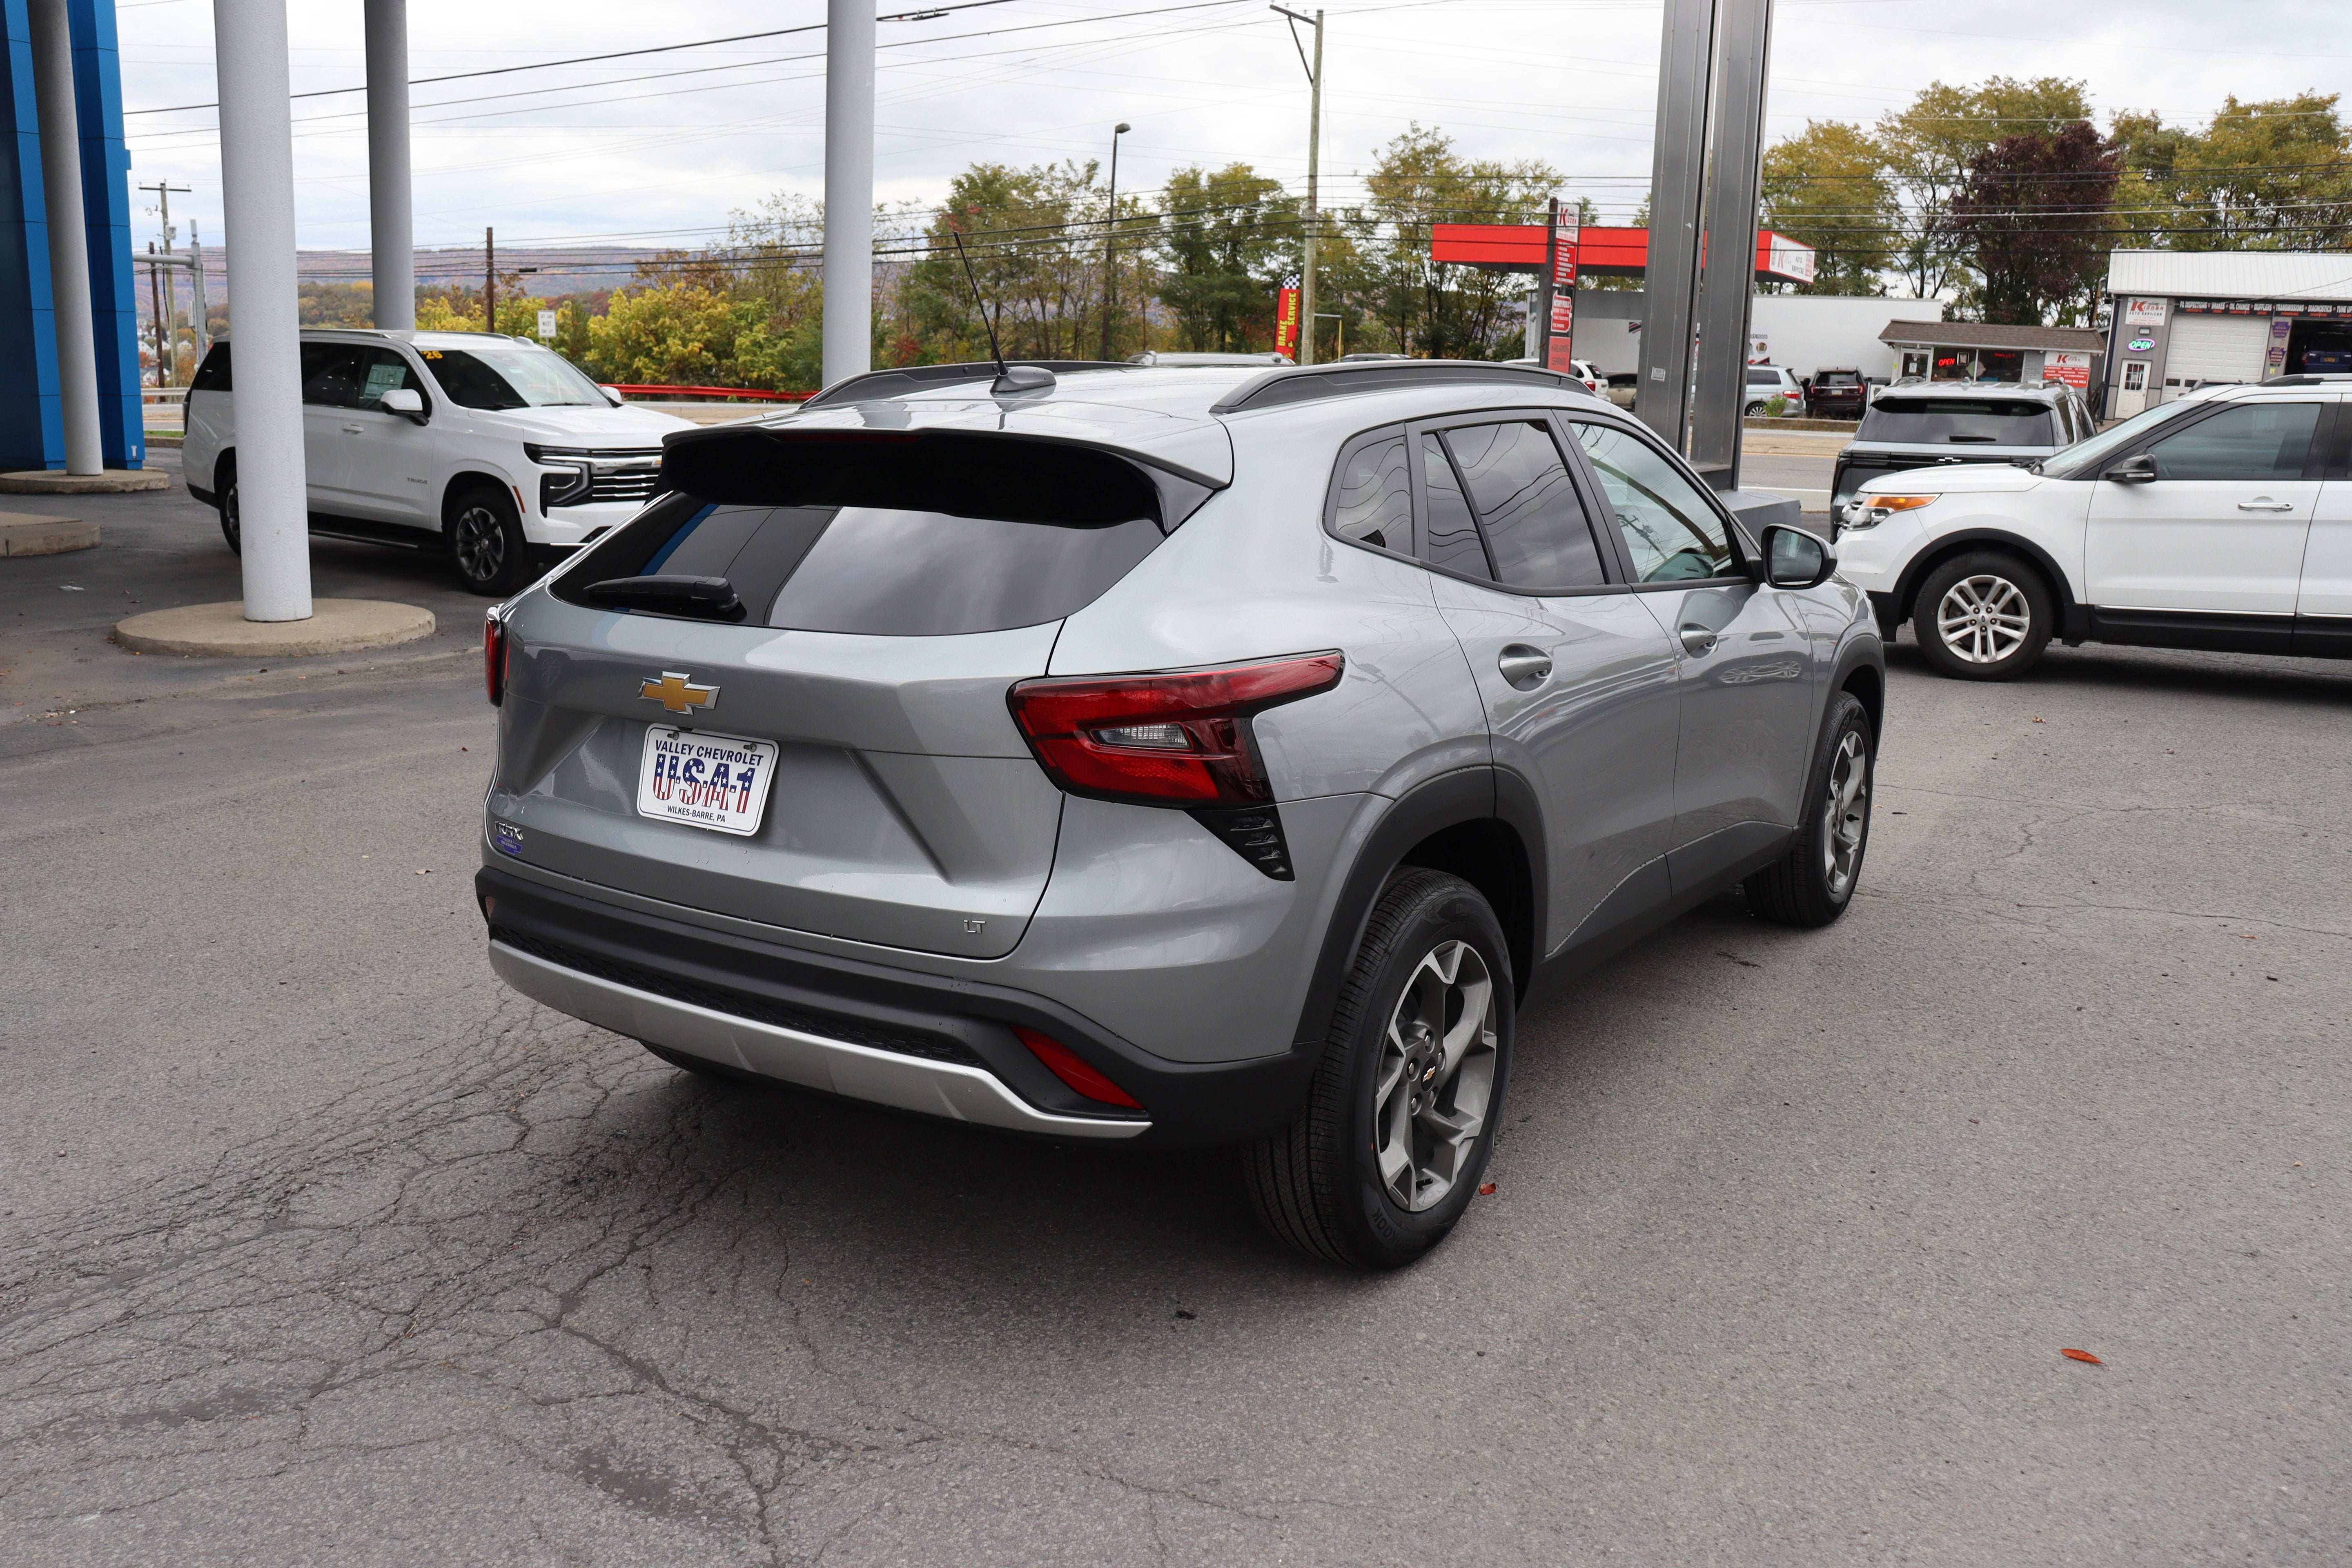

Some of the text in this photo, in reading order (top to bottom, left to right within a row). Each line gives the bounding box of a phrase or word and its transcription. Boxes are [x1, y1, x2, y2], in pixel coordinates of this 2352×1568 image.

[1287, 292, 1297, 326] SERVICE
[2236, 303, 2251, 311] CHANGE
[2253, 303, 2272, 311] MUFFLERS
[2276, 304, 2305, 312] TRANSMISSIONS
[2307, 305, 2332, 313] DIAGNOSTICS
[1277, 320, 1287, 346] BRAKE
[2130, 340, 2153, 350] OPEN
[1938, 358, 1956, 367] OPEN
[656, 739, 764, 766] VALLEY CHEVROLET
[667, 805, 726, 823] WILKES-BARRE, PA
[963, 920, 986, 934] LT
